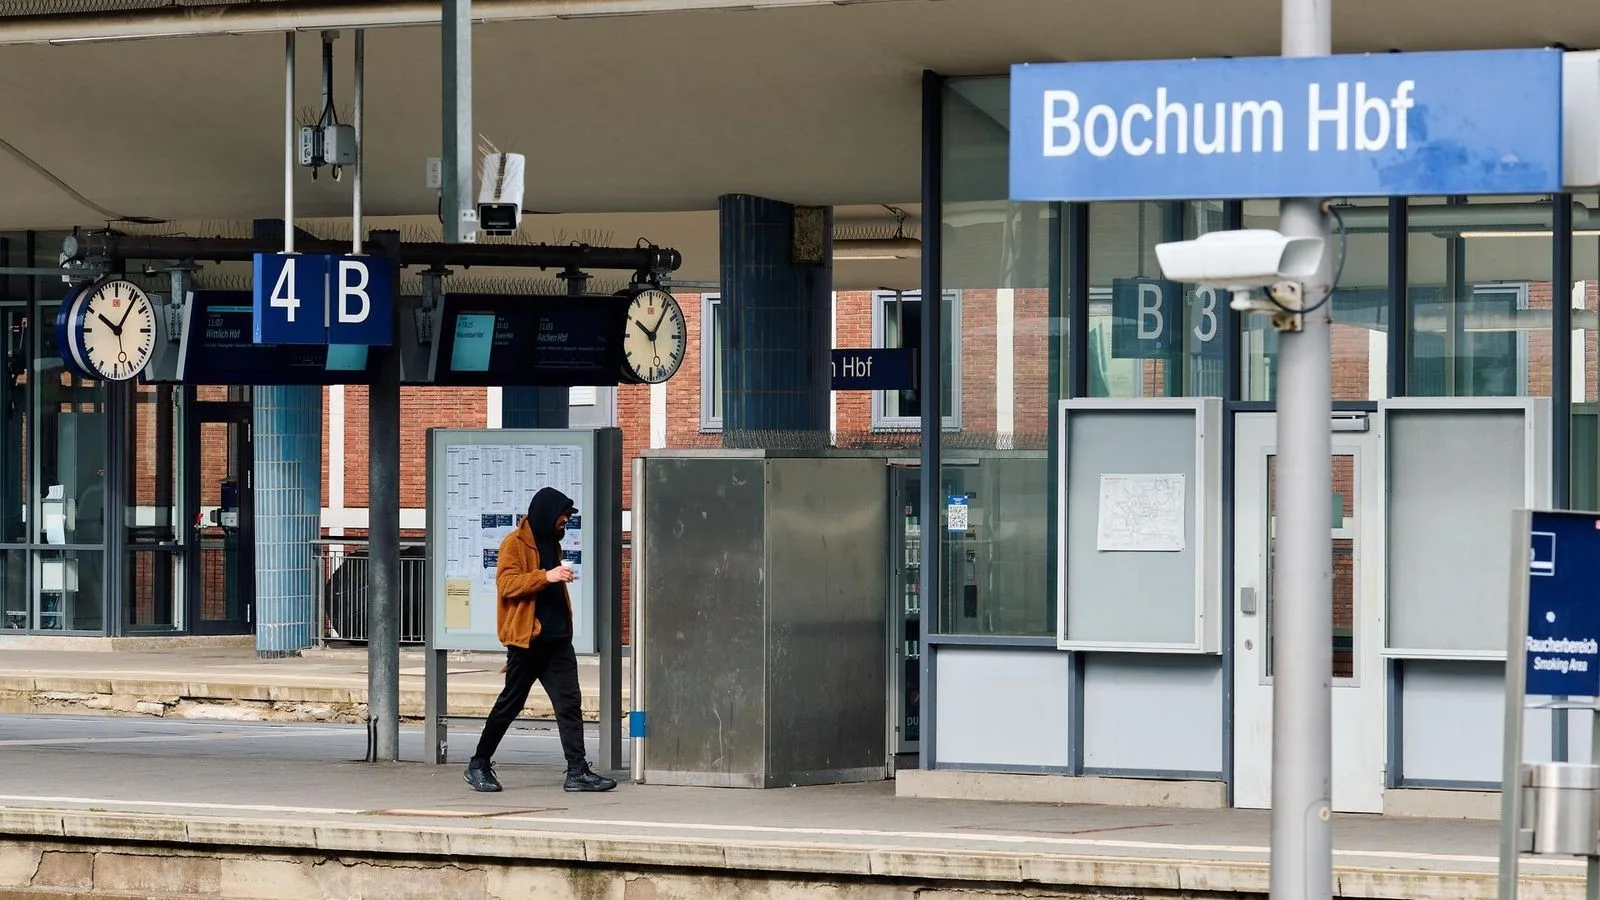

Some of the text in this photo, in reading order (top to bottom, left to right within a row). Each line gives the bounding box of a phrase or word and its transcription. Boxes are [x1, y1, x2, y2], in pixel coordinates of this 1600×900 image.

[1043, 80, 1415, 157] Bochum Hbf
[270, 258, 370, 323] 4 B
[1137, 283, 1217, 342] B 3
[229, 329, 241, 339] Hbf
[558, 333, 568, 342] Hbf
[843, 356, 872, 377] Hbf
[1534, 656, 1588, 673] Smoking Area
